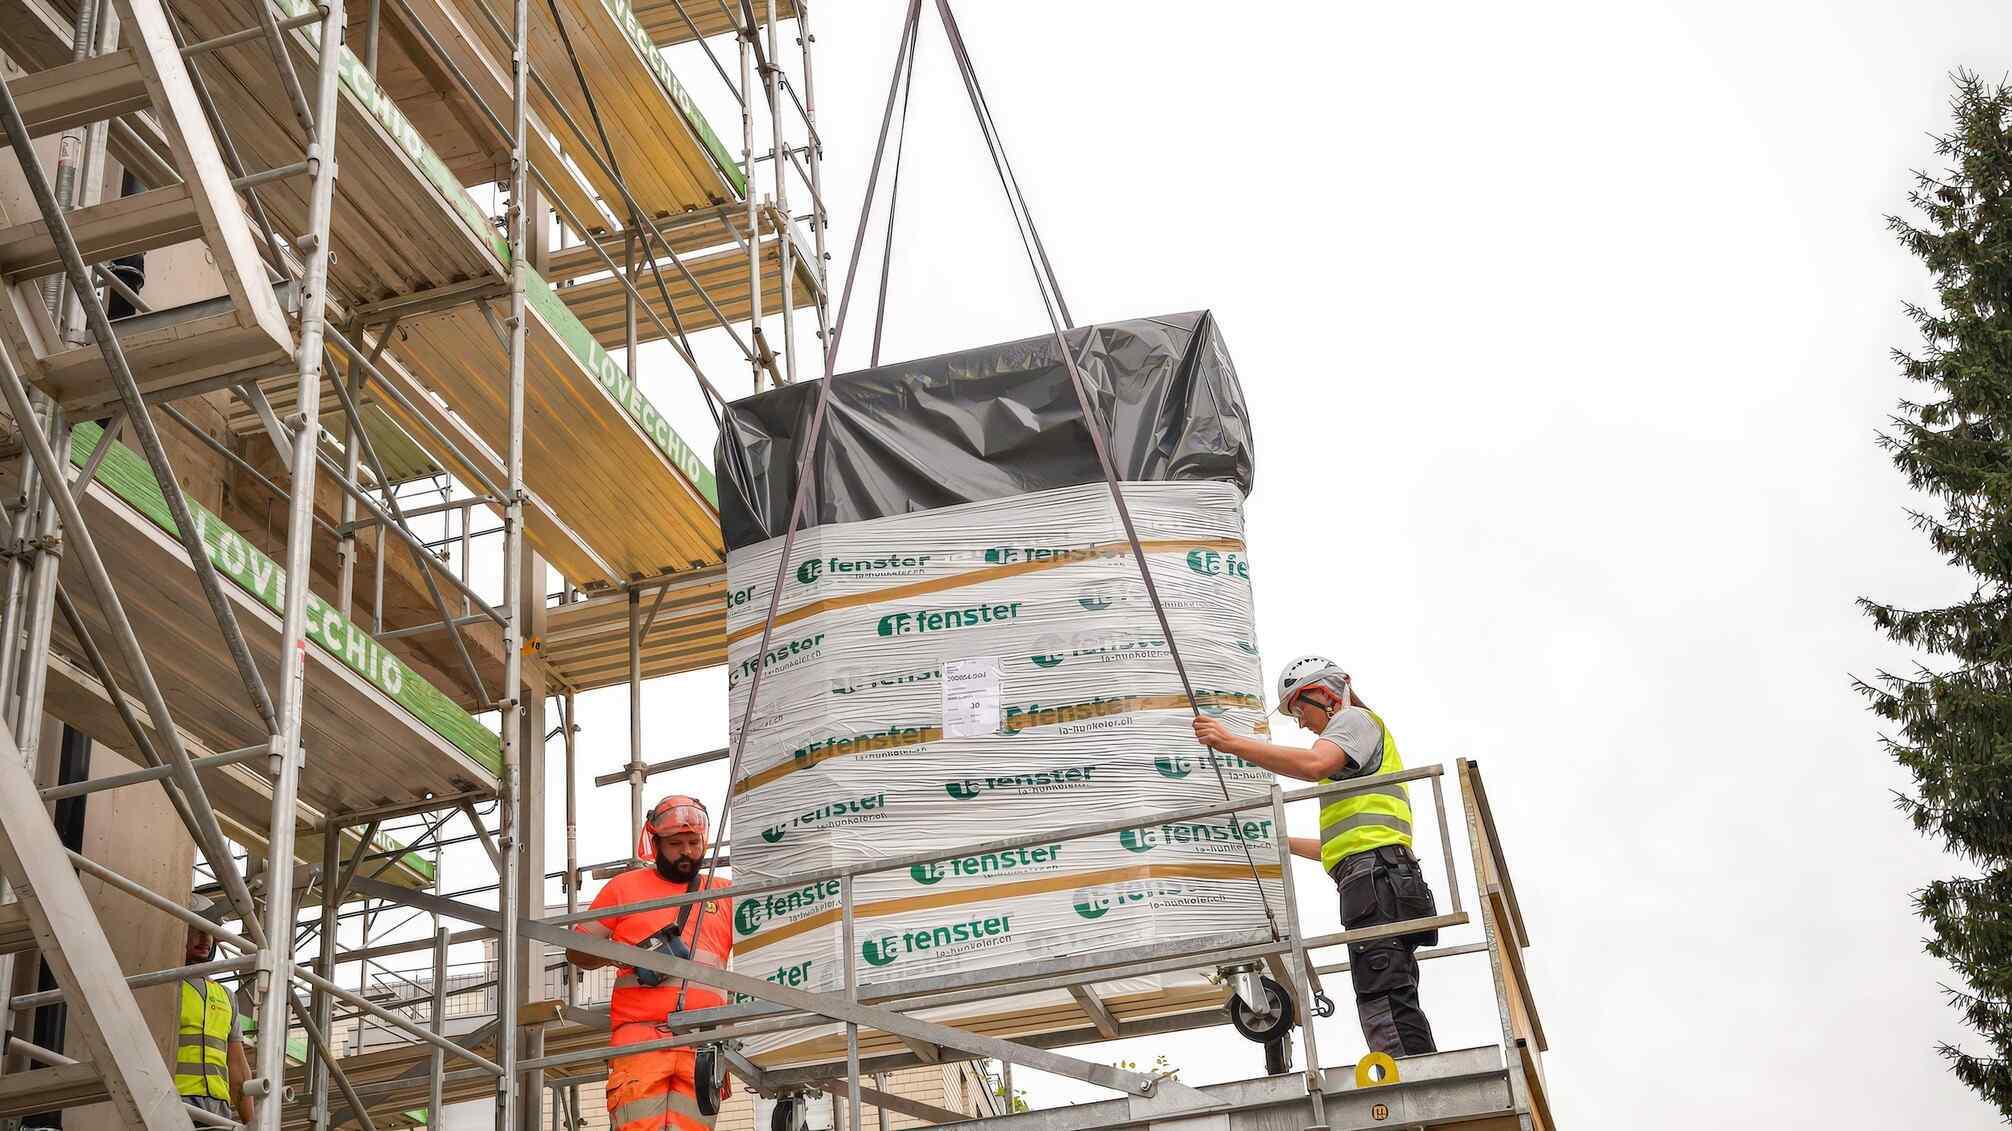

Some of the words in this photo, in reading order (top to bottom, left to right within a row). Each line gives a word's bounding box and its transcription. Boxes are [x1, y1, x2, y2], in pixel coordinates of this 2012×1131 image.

[588, 340, 701, 482] LOVECCHIO
[828, 554, 931, 573] fenster
[916, 602, 1022, 633] fenster
[741, 633, 825, 678] fenster
[1161, 819, 1272, 844] fenster
[950, 845, 1061, 875] fenster
[766, 879, 840, 920] fenste
[902, 914, 1015, 953] fenster
